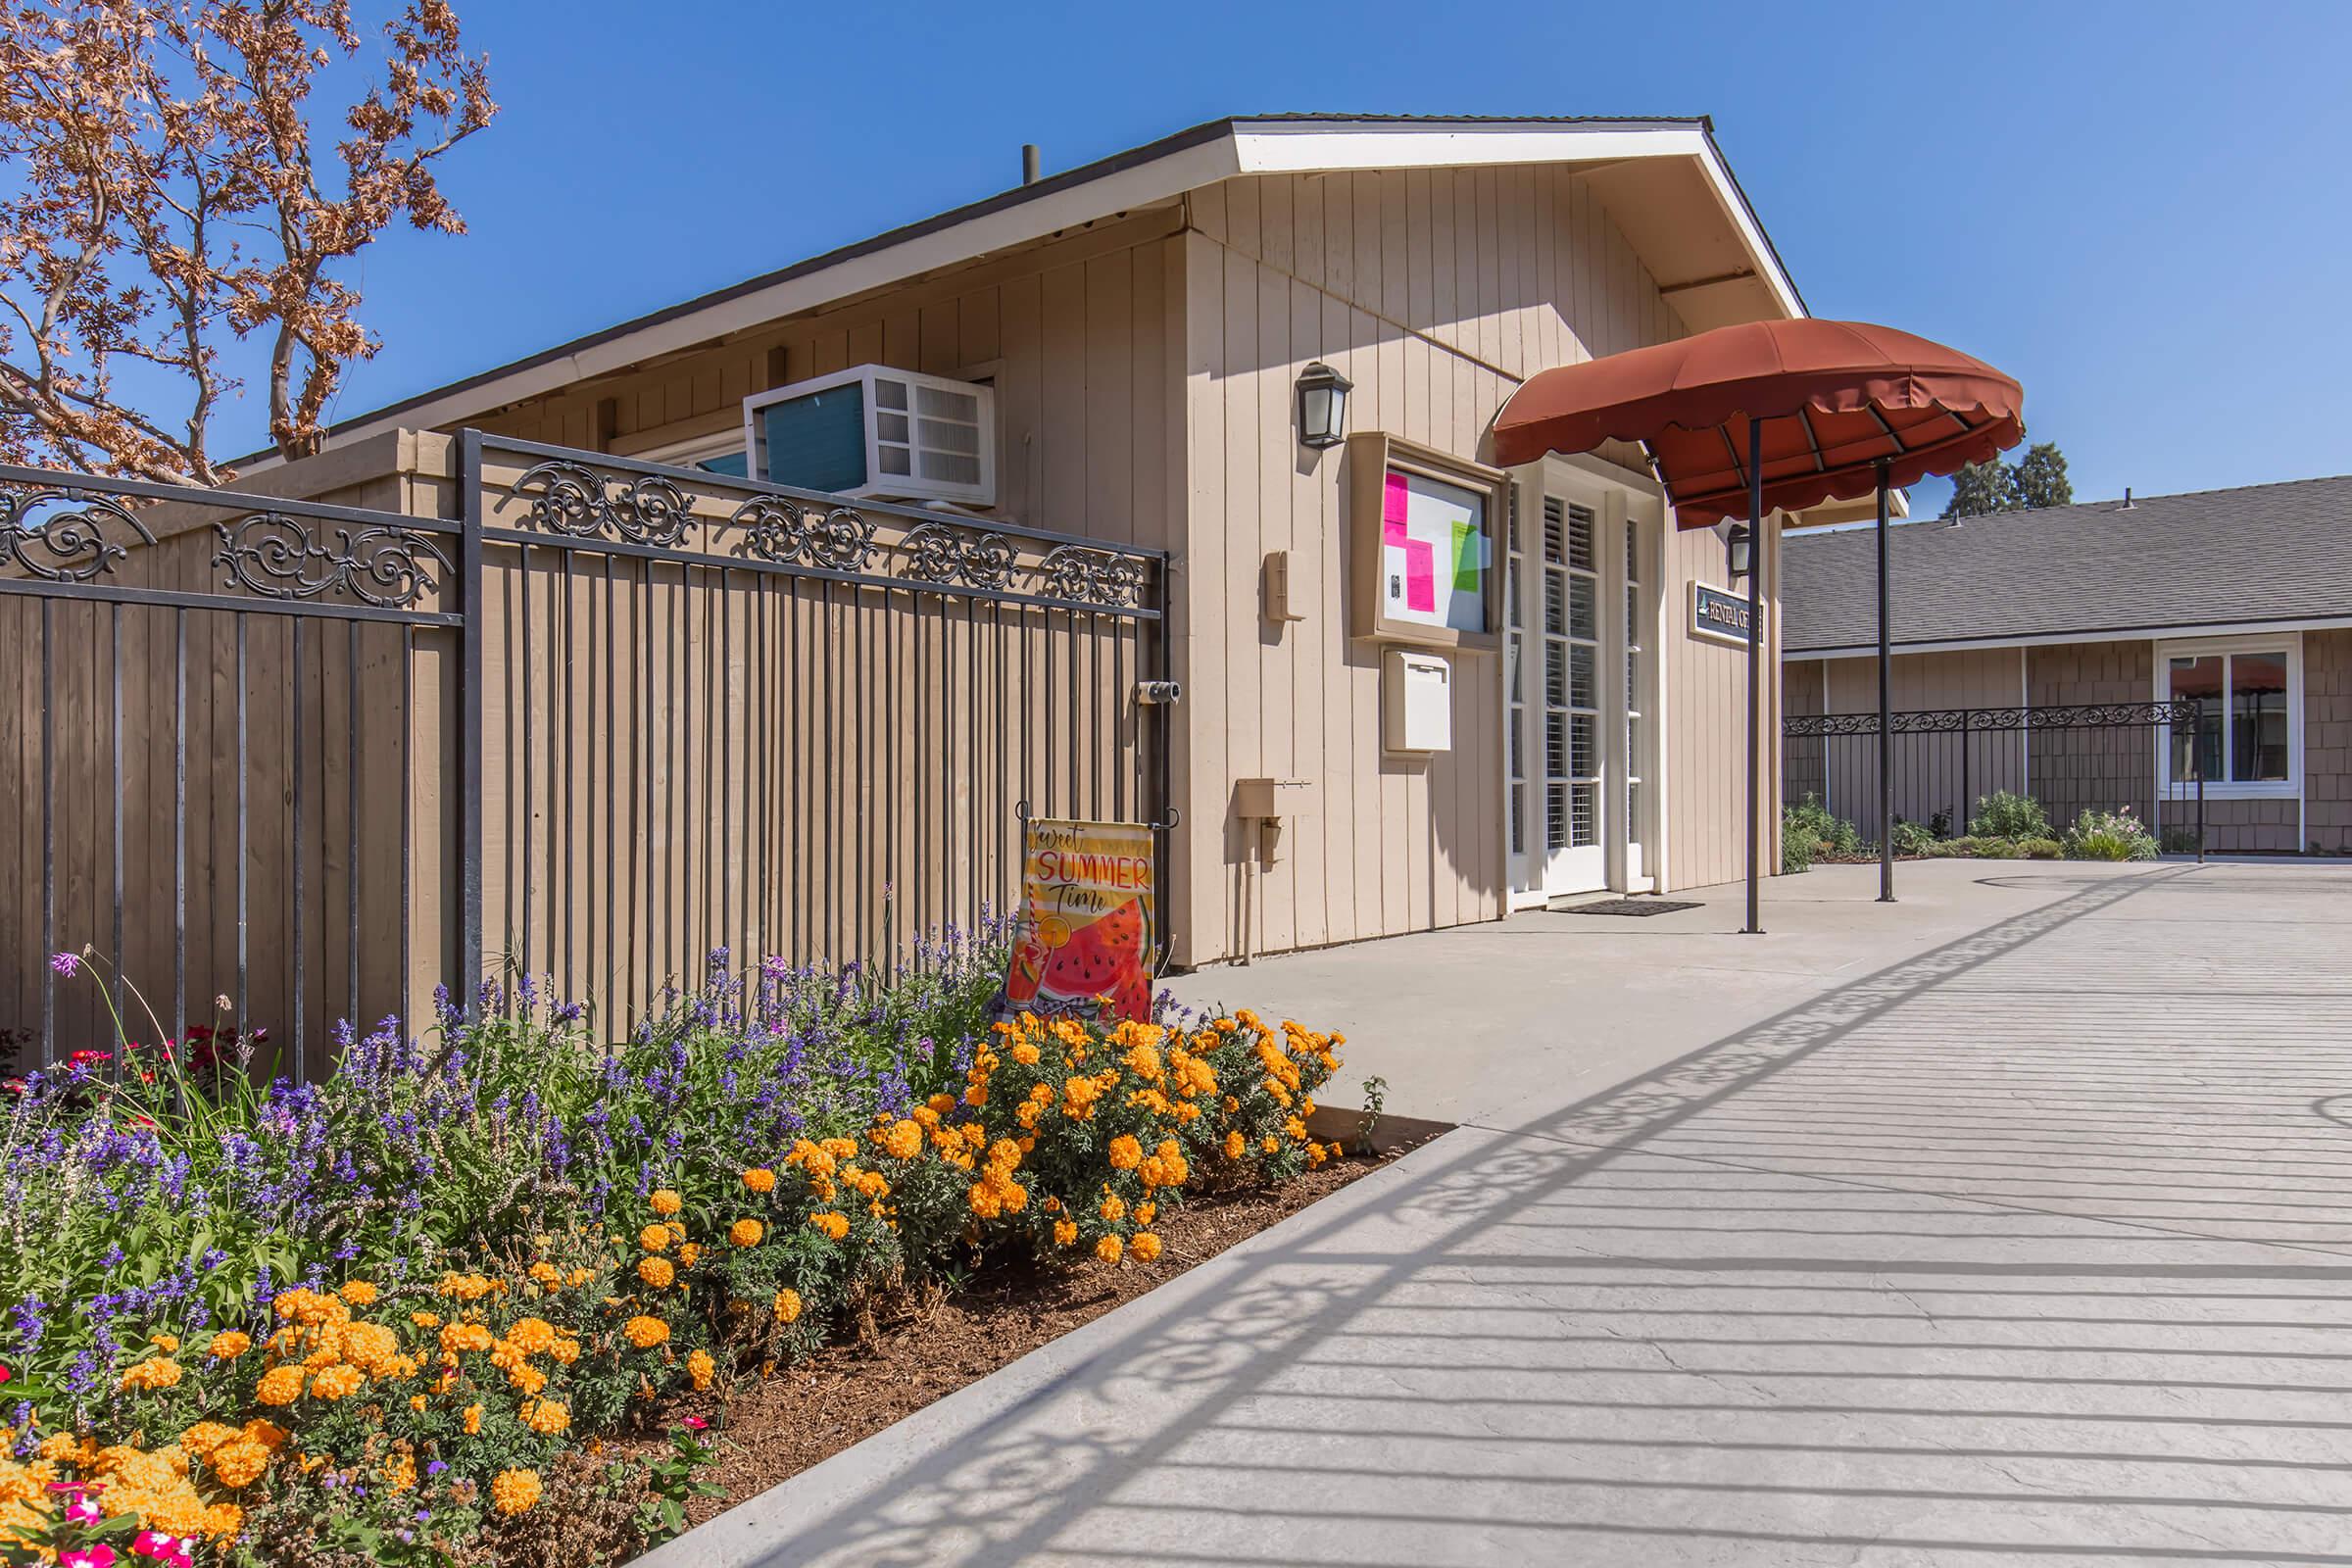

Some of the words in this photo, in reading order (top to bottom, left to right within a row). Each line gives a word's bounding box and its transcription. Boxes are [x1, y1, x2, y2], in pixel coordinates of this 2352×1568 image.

[1709, 601, 1738, 626] RENTAL
[1030, 822, 1085, 854] Sweet
[1038, 851, 1150, 890] SUMMER
[1049, 883, 1106, 915] Time
